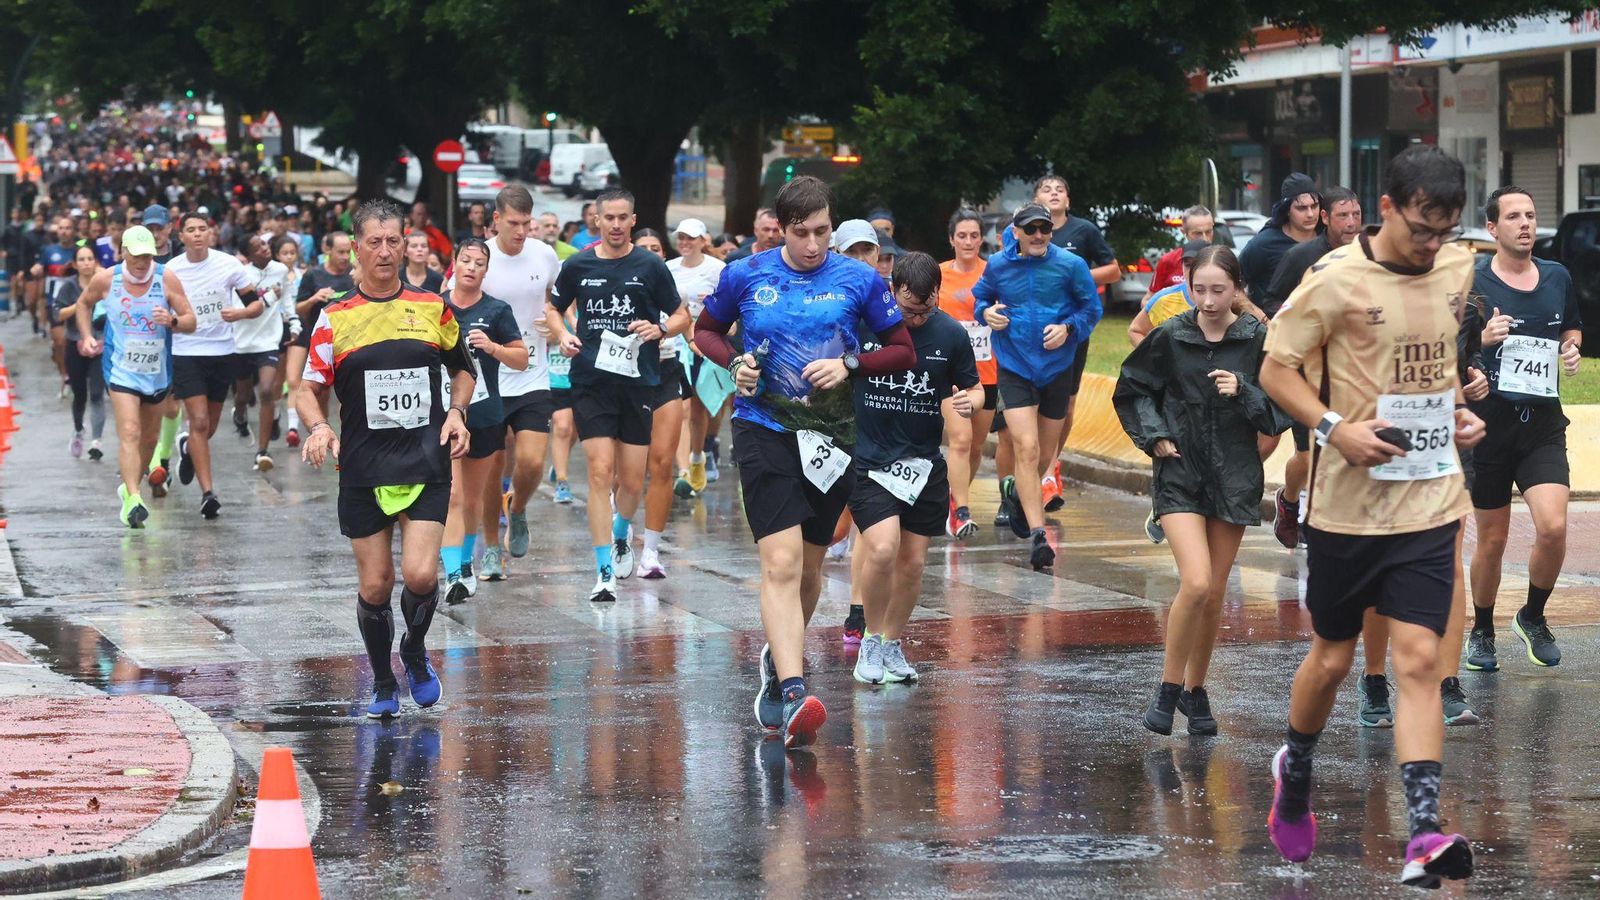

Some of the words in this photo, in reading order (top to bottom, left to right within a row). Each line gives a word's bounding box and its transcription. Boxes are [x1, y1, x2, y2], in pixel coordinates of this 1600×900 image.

[196, 301, 223, 316] 3876
[127, 351, 159, 364] 12786
[608, 344, 633, 361] 678
[1513, 358, 1550, 379] 7441
[378, 392, 421, 412] 5101
[864, 392, 902, 403] CARRERA
[864, 399, 903, 411] URBANA
